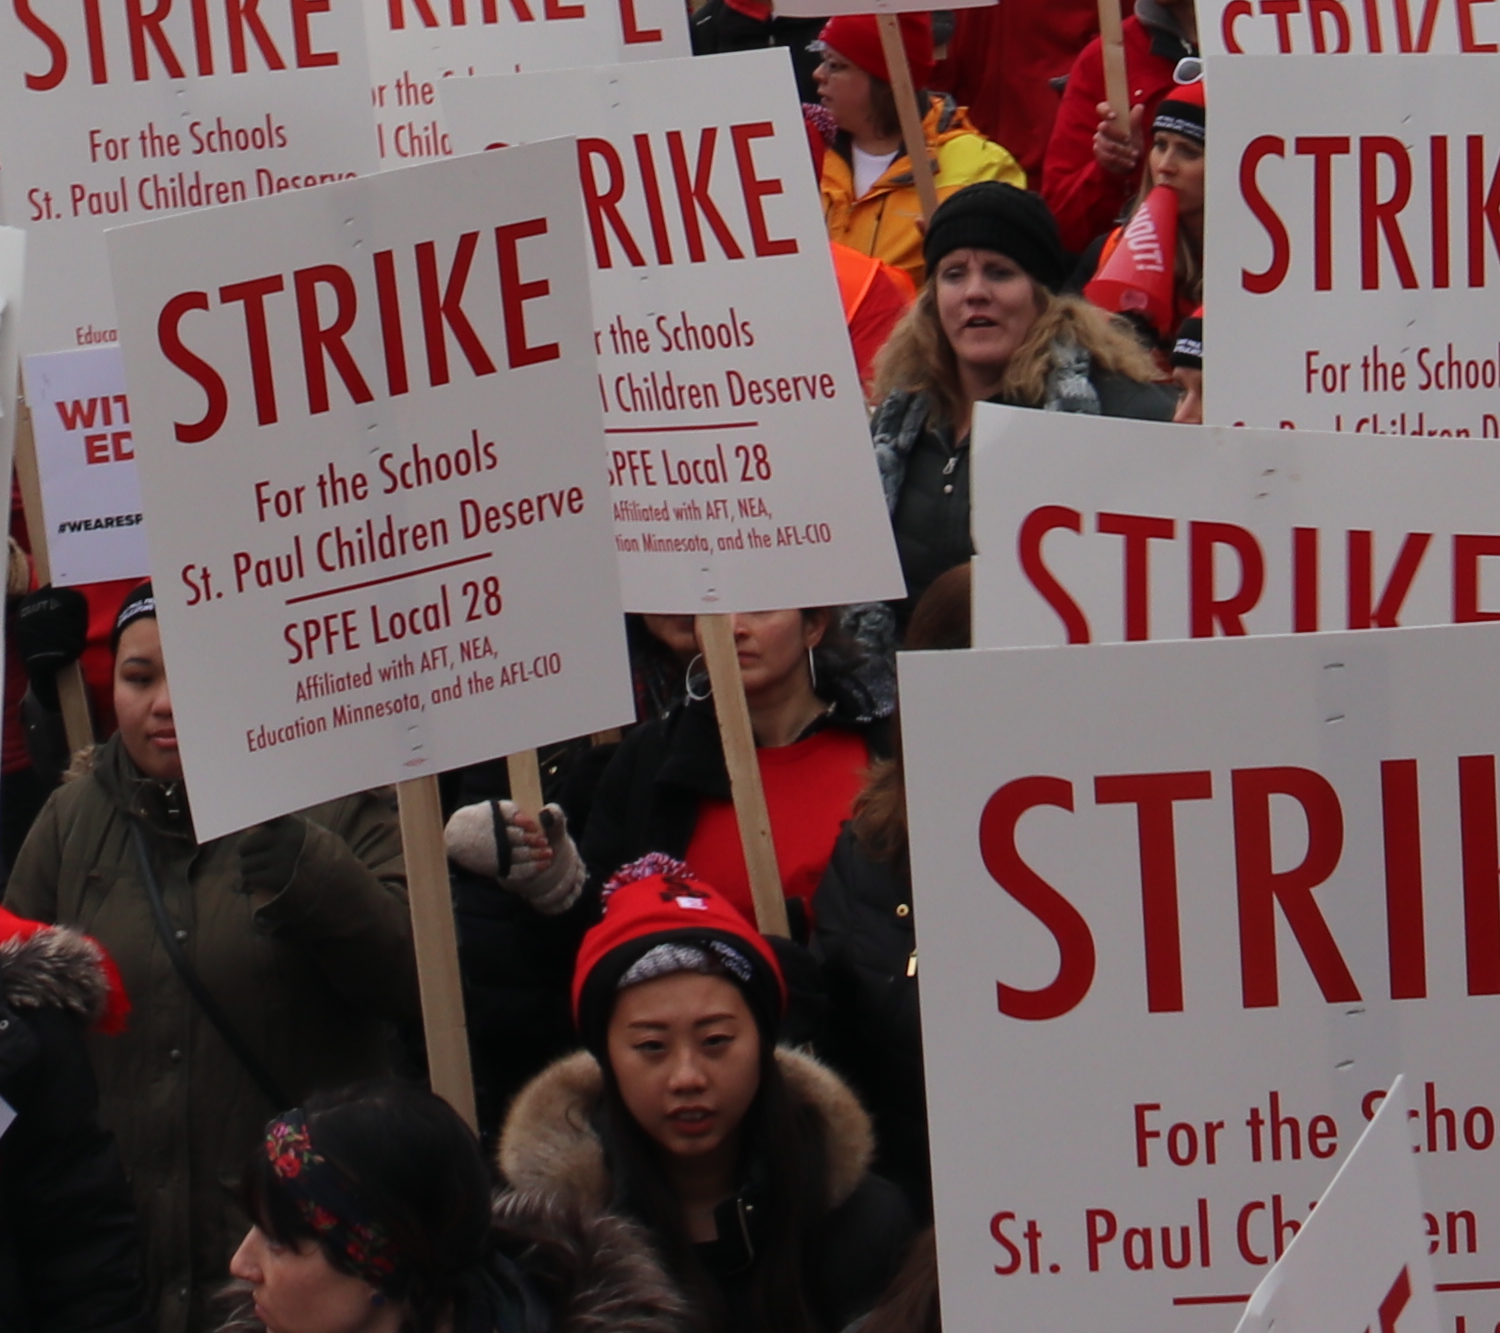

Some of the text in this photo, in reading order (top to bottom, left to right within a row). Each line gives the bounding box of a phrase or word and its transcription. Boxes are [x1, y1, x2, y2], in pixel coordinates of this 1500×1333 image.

[158, 218, 560, 443] STRIKE
[255, 429, 497, 522] For the Schools
[182, 487, 583, 606] St. Paul Children Deserve
[284, 576, 502, 664] SPFE Local 28
[246, 653, 561, 752] Education Minnesota, and the AFL-CIO
[296, 636, 498, 708] Affiliated with AFT, NEA,
